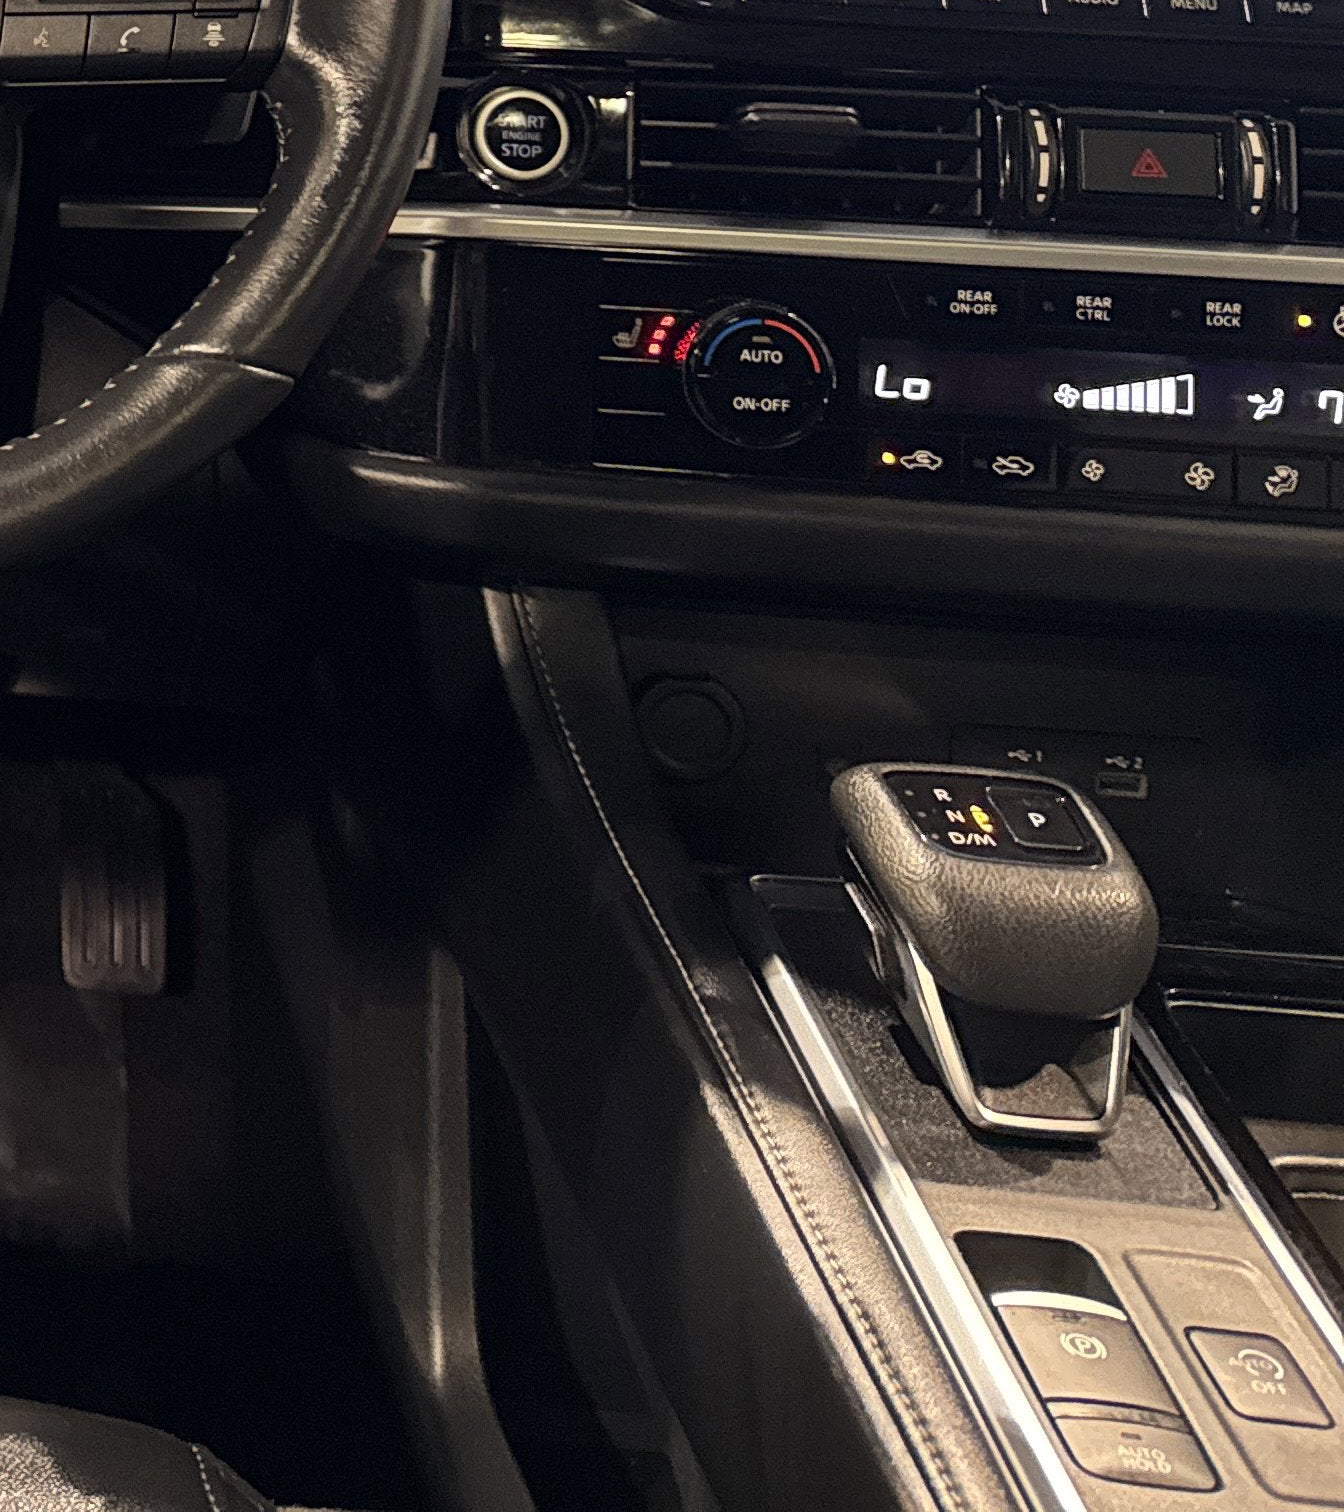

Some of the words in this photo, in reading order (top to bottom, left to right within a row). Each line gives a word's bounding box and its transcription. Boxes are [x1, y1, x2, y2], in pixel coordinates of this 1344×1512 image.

[1275, 0, 1314, 16] MAP
[498, 113, 547, 129] START
[501, 130, 542, 141] ENGINE
[501, 143, 543, 158] STOP
[957, 289, 993, 303] REAR
[1076, 295, 1112, 309] REAR
[949, 302, 999, 316] ON-OFF
[1076, 308, 1111, 322] CTRL
[1205, 301, 1242, 316] REAR
[1206, 315, 1242, 328] LOCK
[739, 348, 784, 365] AUTO
[874, 363, 932, 402] Lo
[732, 395, 792, 413] ON-OFF
[932, 787, 953, 803] R
[945, 808, 966, 824] N
[1028, 811, 1046, 828] P
[947, 830, 998, 848] D/M
[1250, 1379, 1286, 1396] OFF
[1116, 1443, 1166, 1462] AUTO
[1121, 1455, 1173, 1475] HOLD
